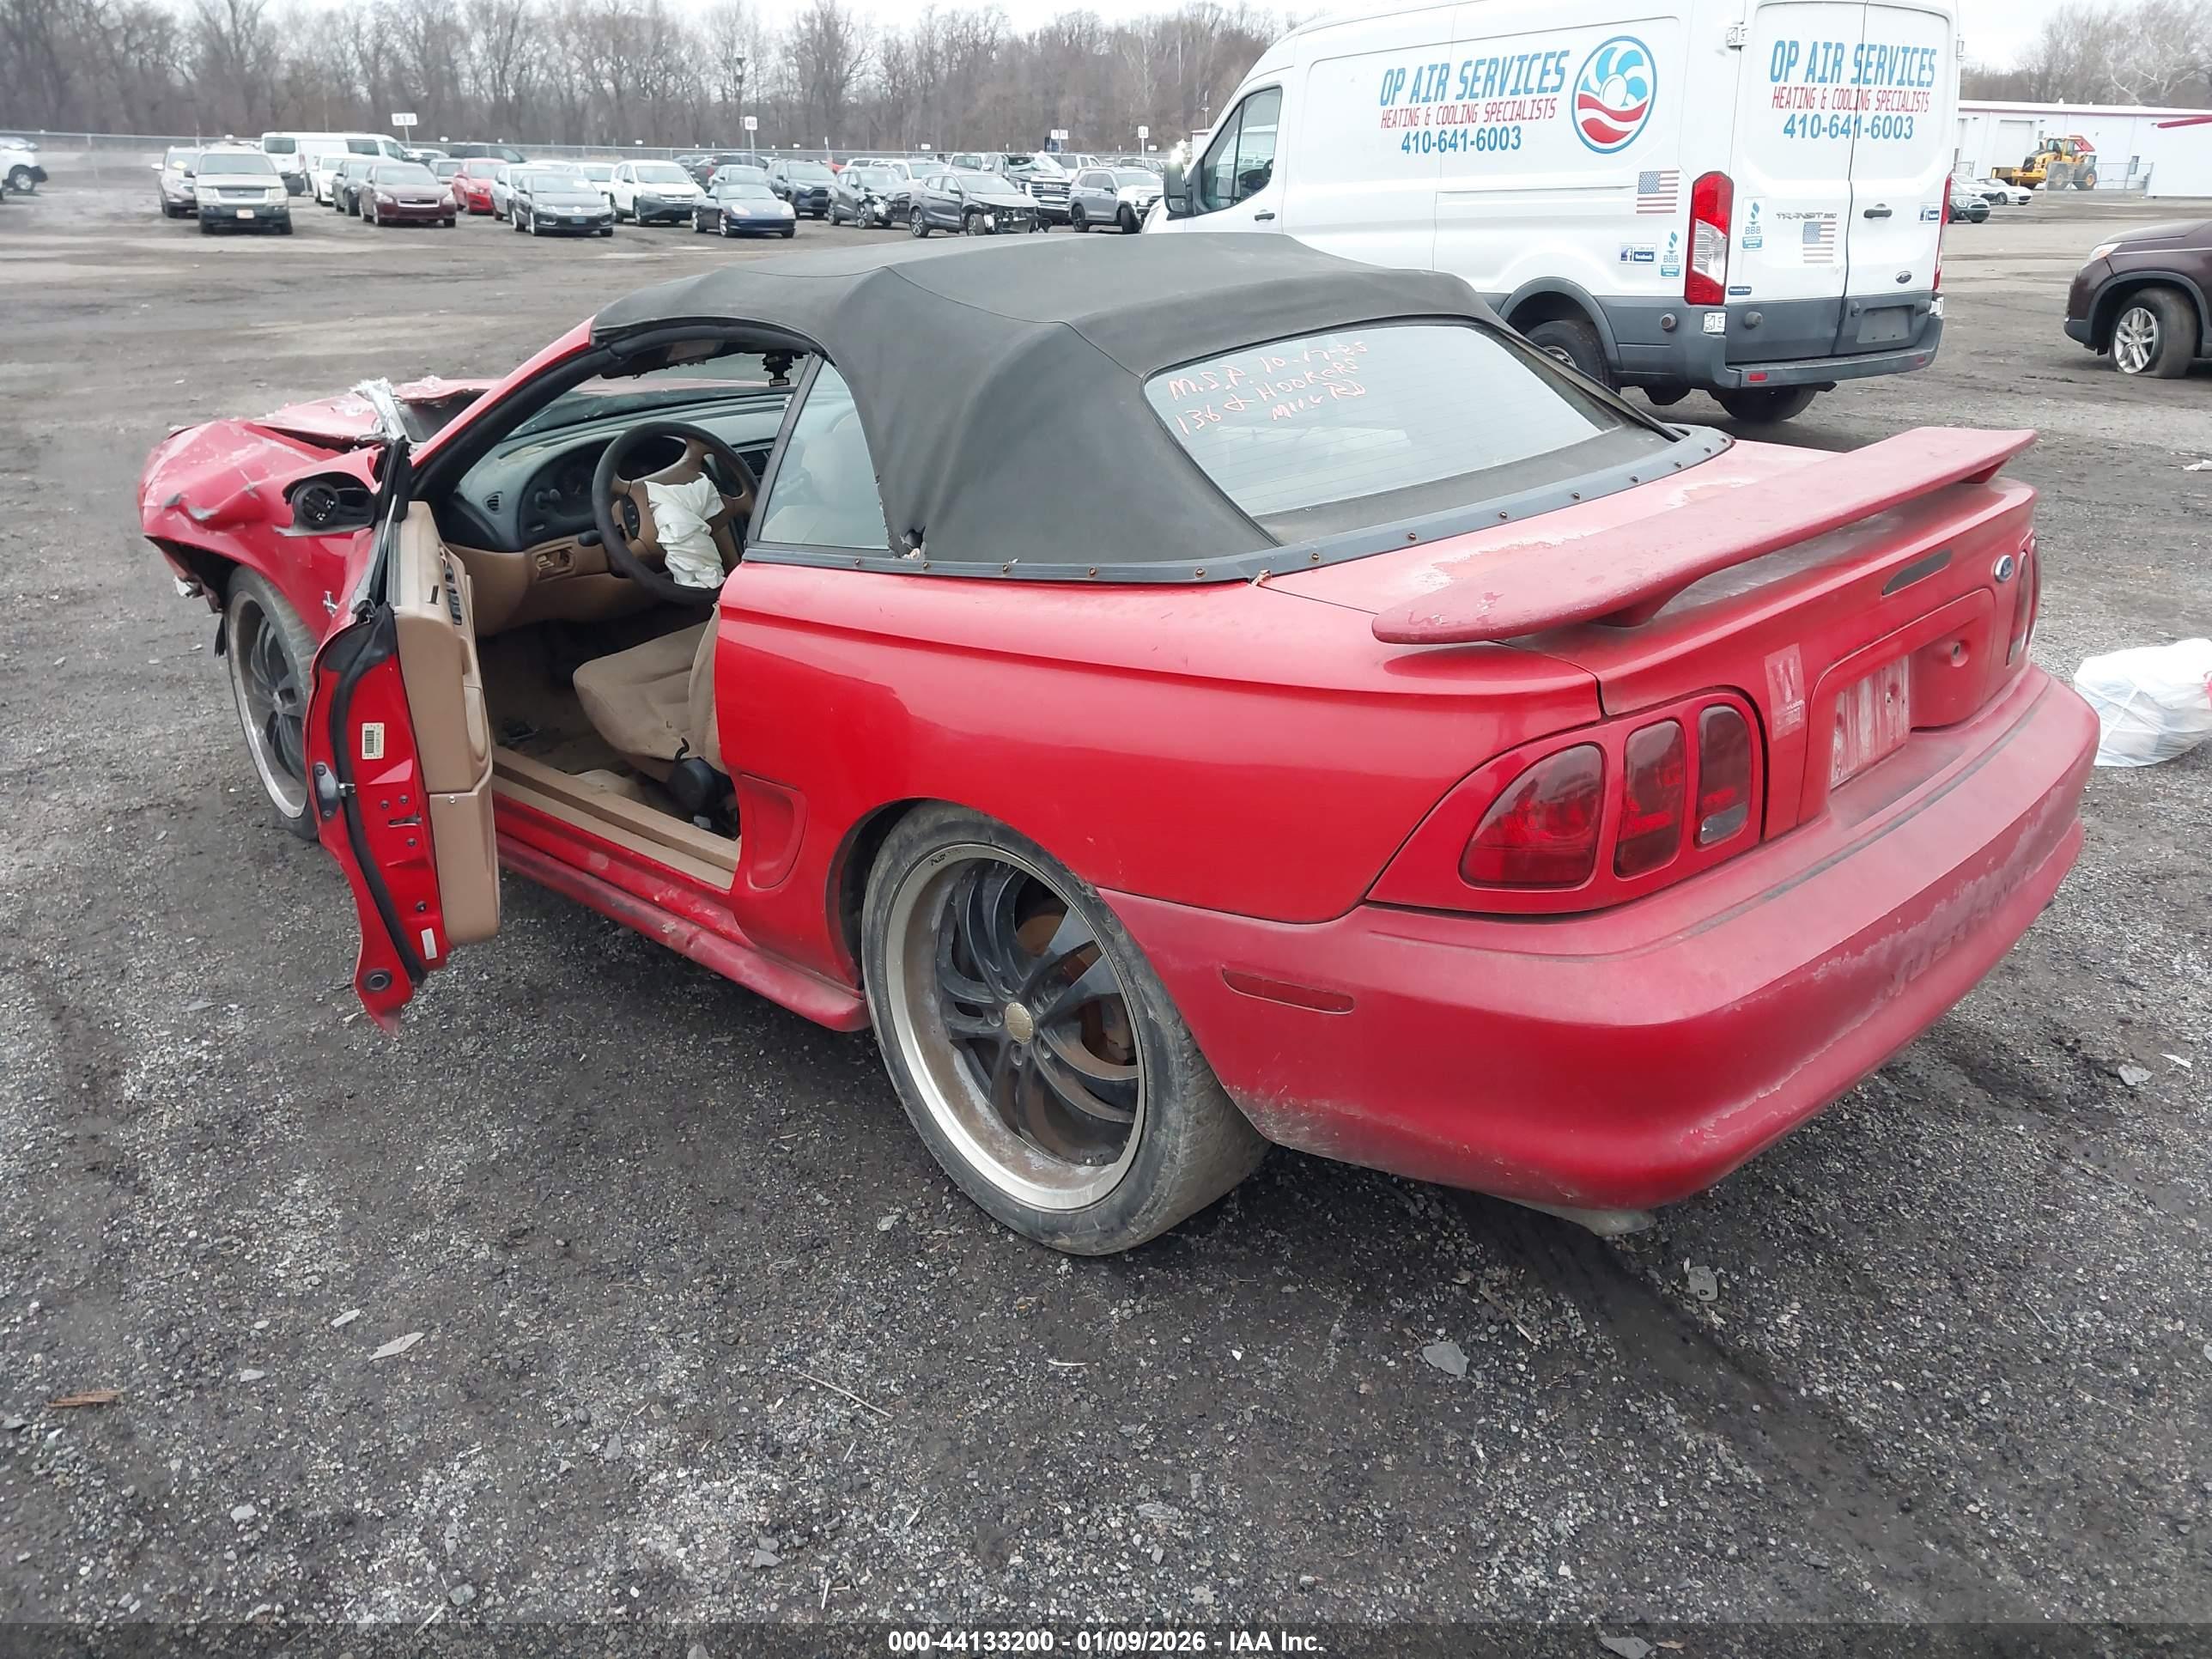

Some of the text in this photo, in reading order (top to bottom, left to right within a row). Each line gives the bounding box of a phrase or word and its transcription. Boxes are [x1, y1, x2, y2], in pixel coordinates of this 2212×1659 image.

[1380, 50, 1570, 106] OP AIR SERVICES
[1770, 40, 1937, 88] OP AIR SERVICES
[1381, 98, 1558, 129] HEATING & COOLING SPECIALISTS
[1772, 86, 1931, 112] HEATING & COOLING SPECIALISTS
[1401, 125, 1522, 154] 410-641-6003
[1784, 113, 1914, 140] 410-641-6003
